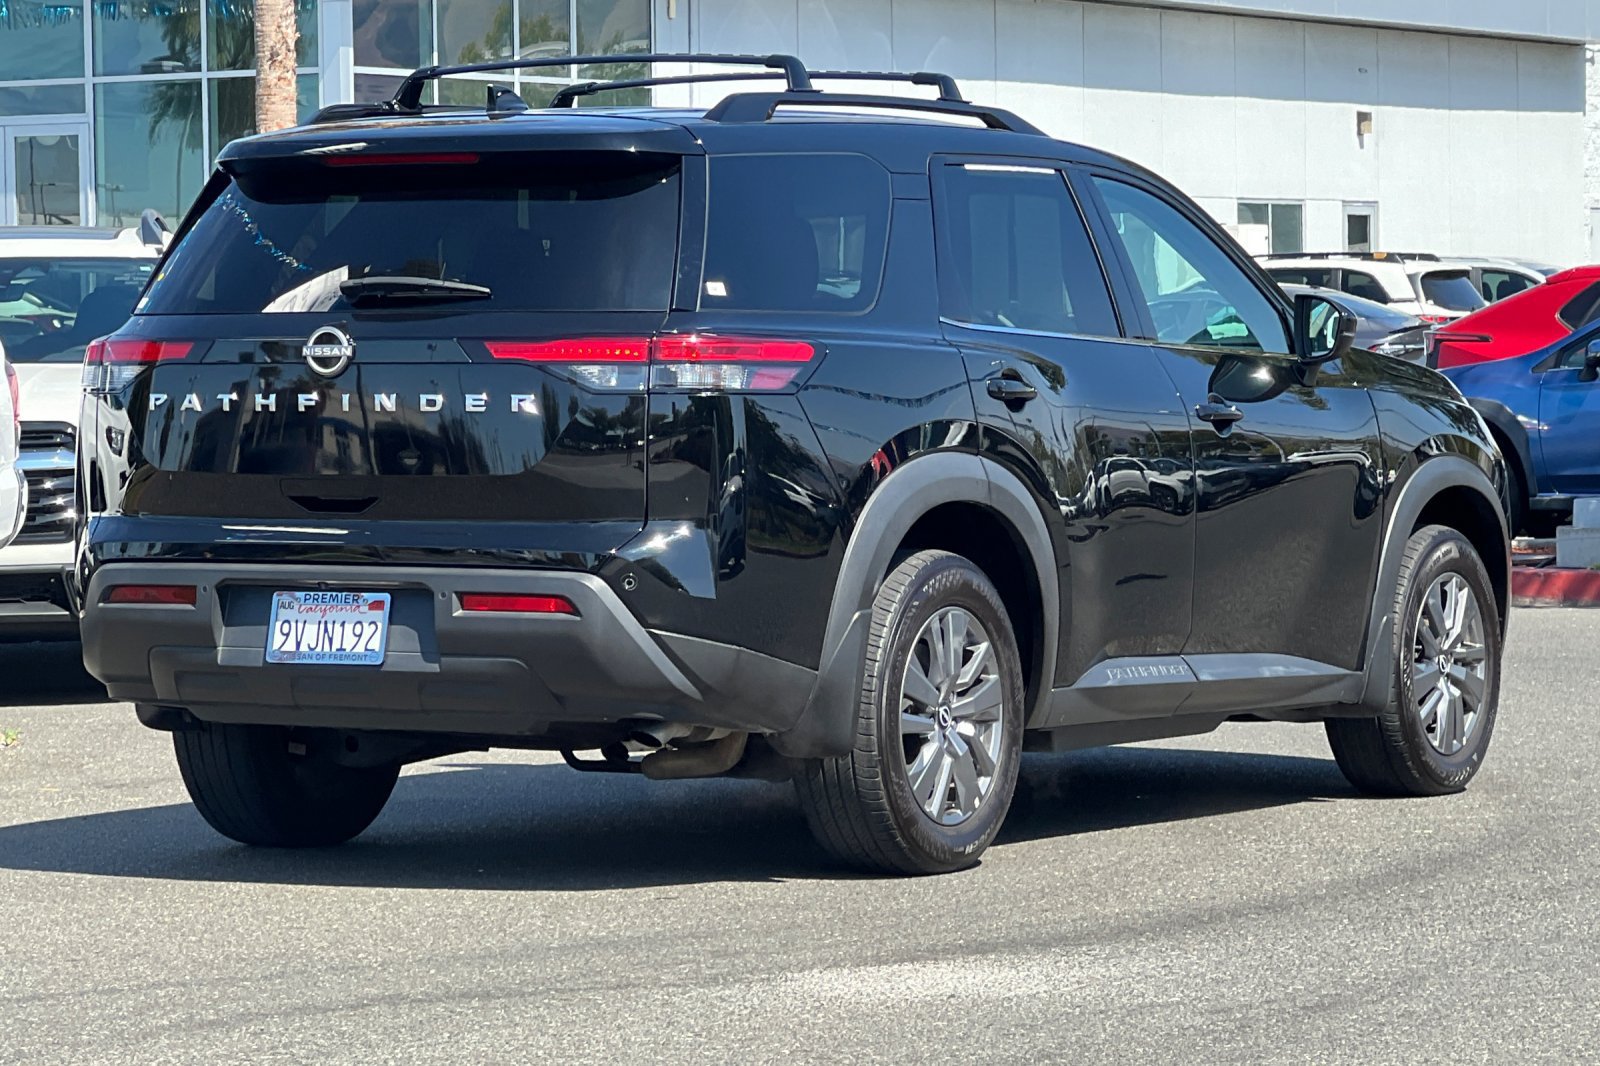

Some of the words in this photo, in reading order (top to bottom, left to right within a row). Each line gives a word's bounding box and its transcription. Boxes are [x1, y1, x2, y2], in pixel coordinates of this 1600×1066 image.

[302, 346, 351, 356] NISSAN
[149, 392, 539, 414] PATHFINDER
[303, 593, 361, 604] PREMIER
[279, 600, 295, 610] AUG
[297, 604, 367, 619] California
[279, 618, 379, 651] 9VJN192
[281, 652, 313, 661] SSAN
[315, 653, 327, 661] OF
[328, 653, 368, 662] FREMONT
